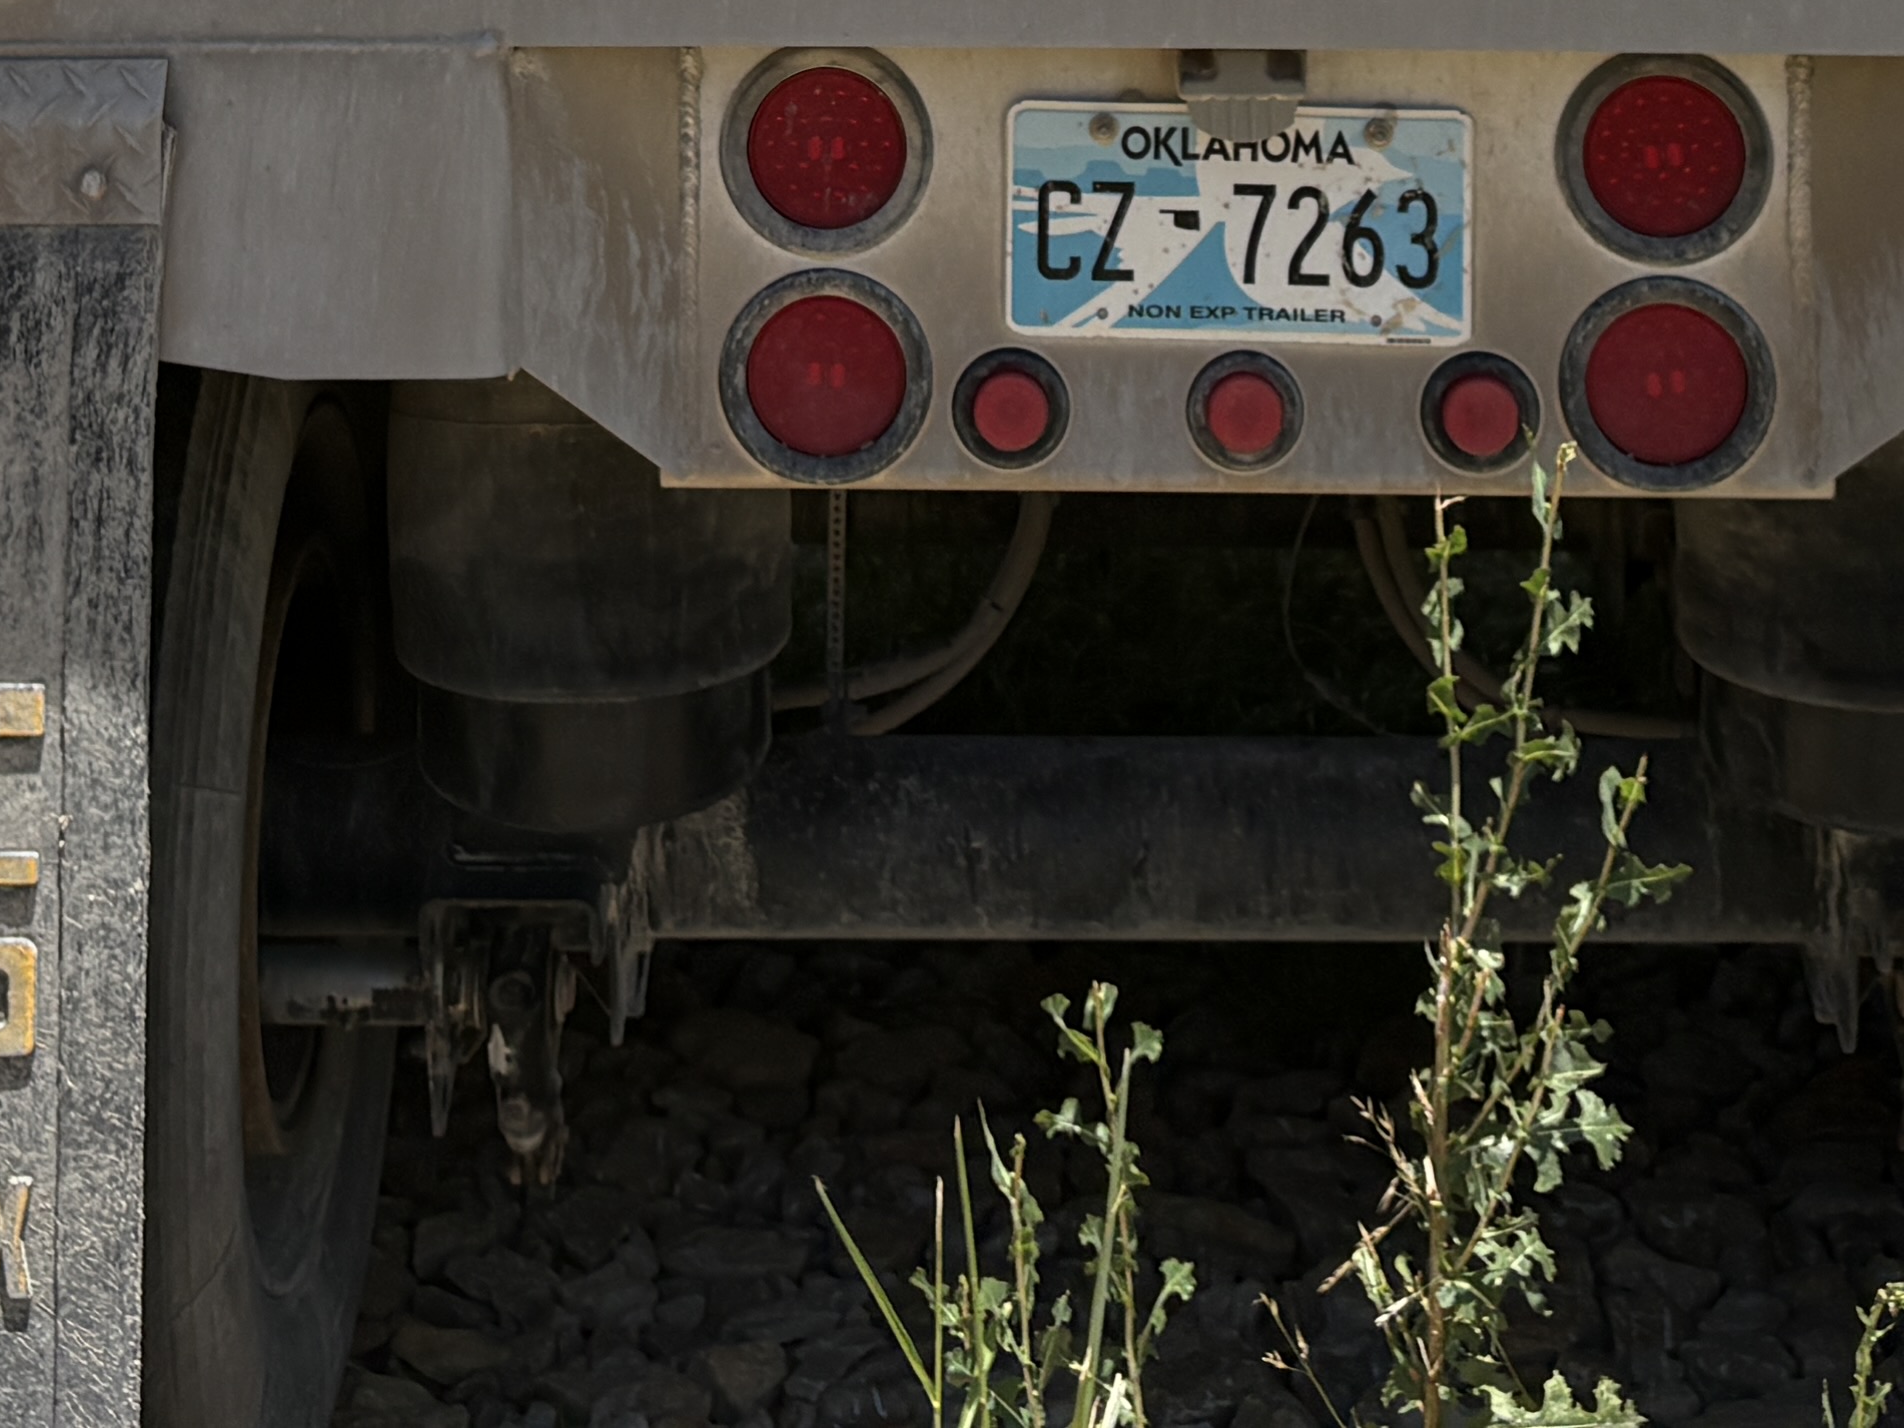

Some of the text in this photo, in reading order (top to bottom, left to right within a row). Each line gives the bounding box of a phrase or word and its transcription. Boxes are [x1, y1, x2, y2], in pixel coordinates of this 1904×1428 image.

[1127, 303, 1346, 324] NON EXP TRAILER
